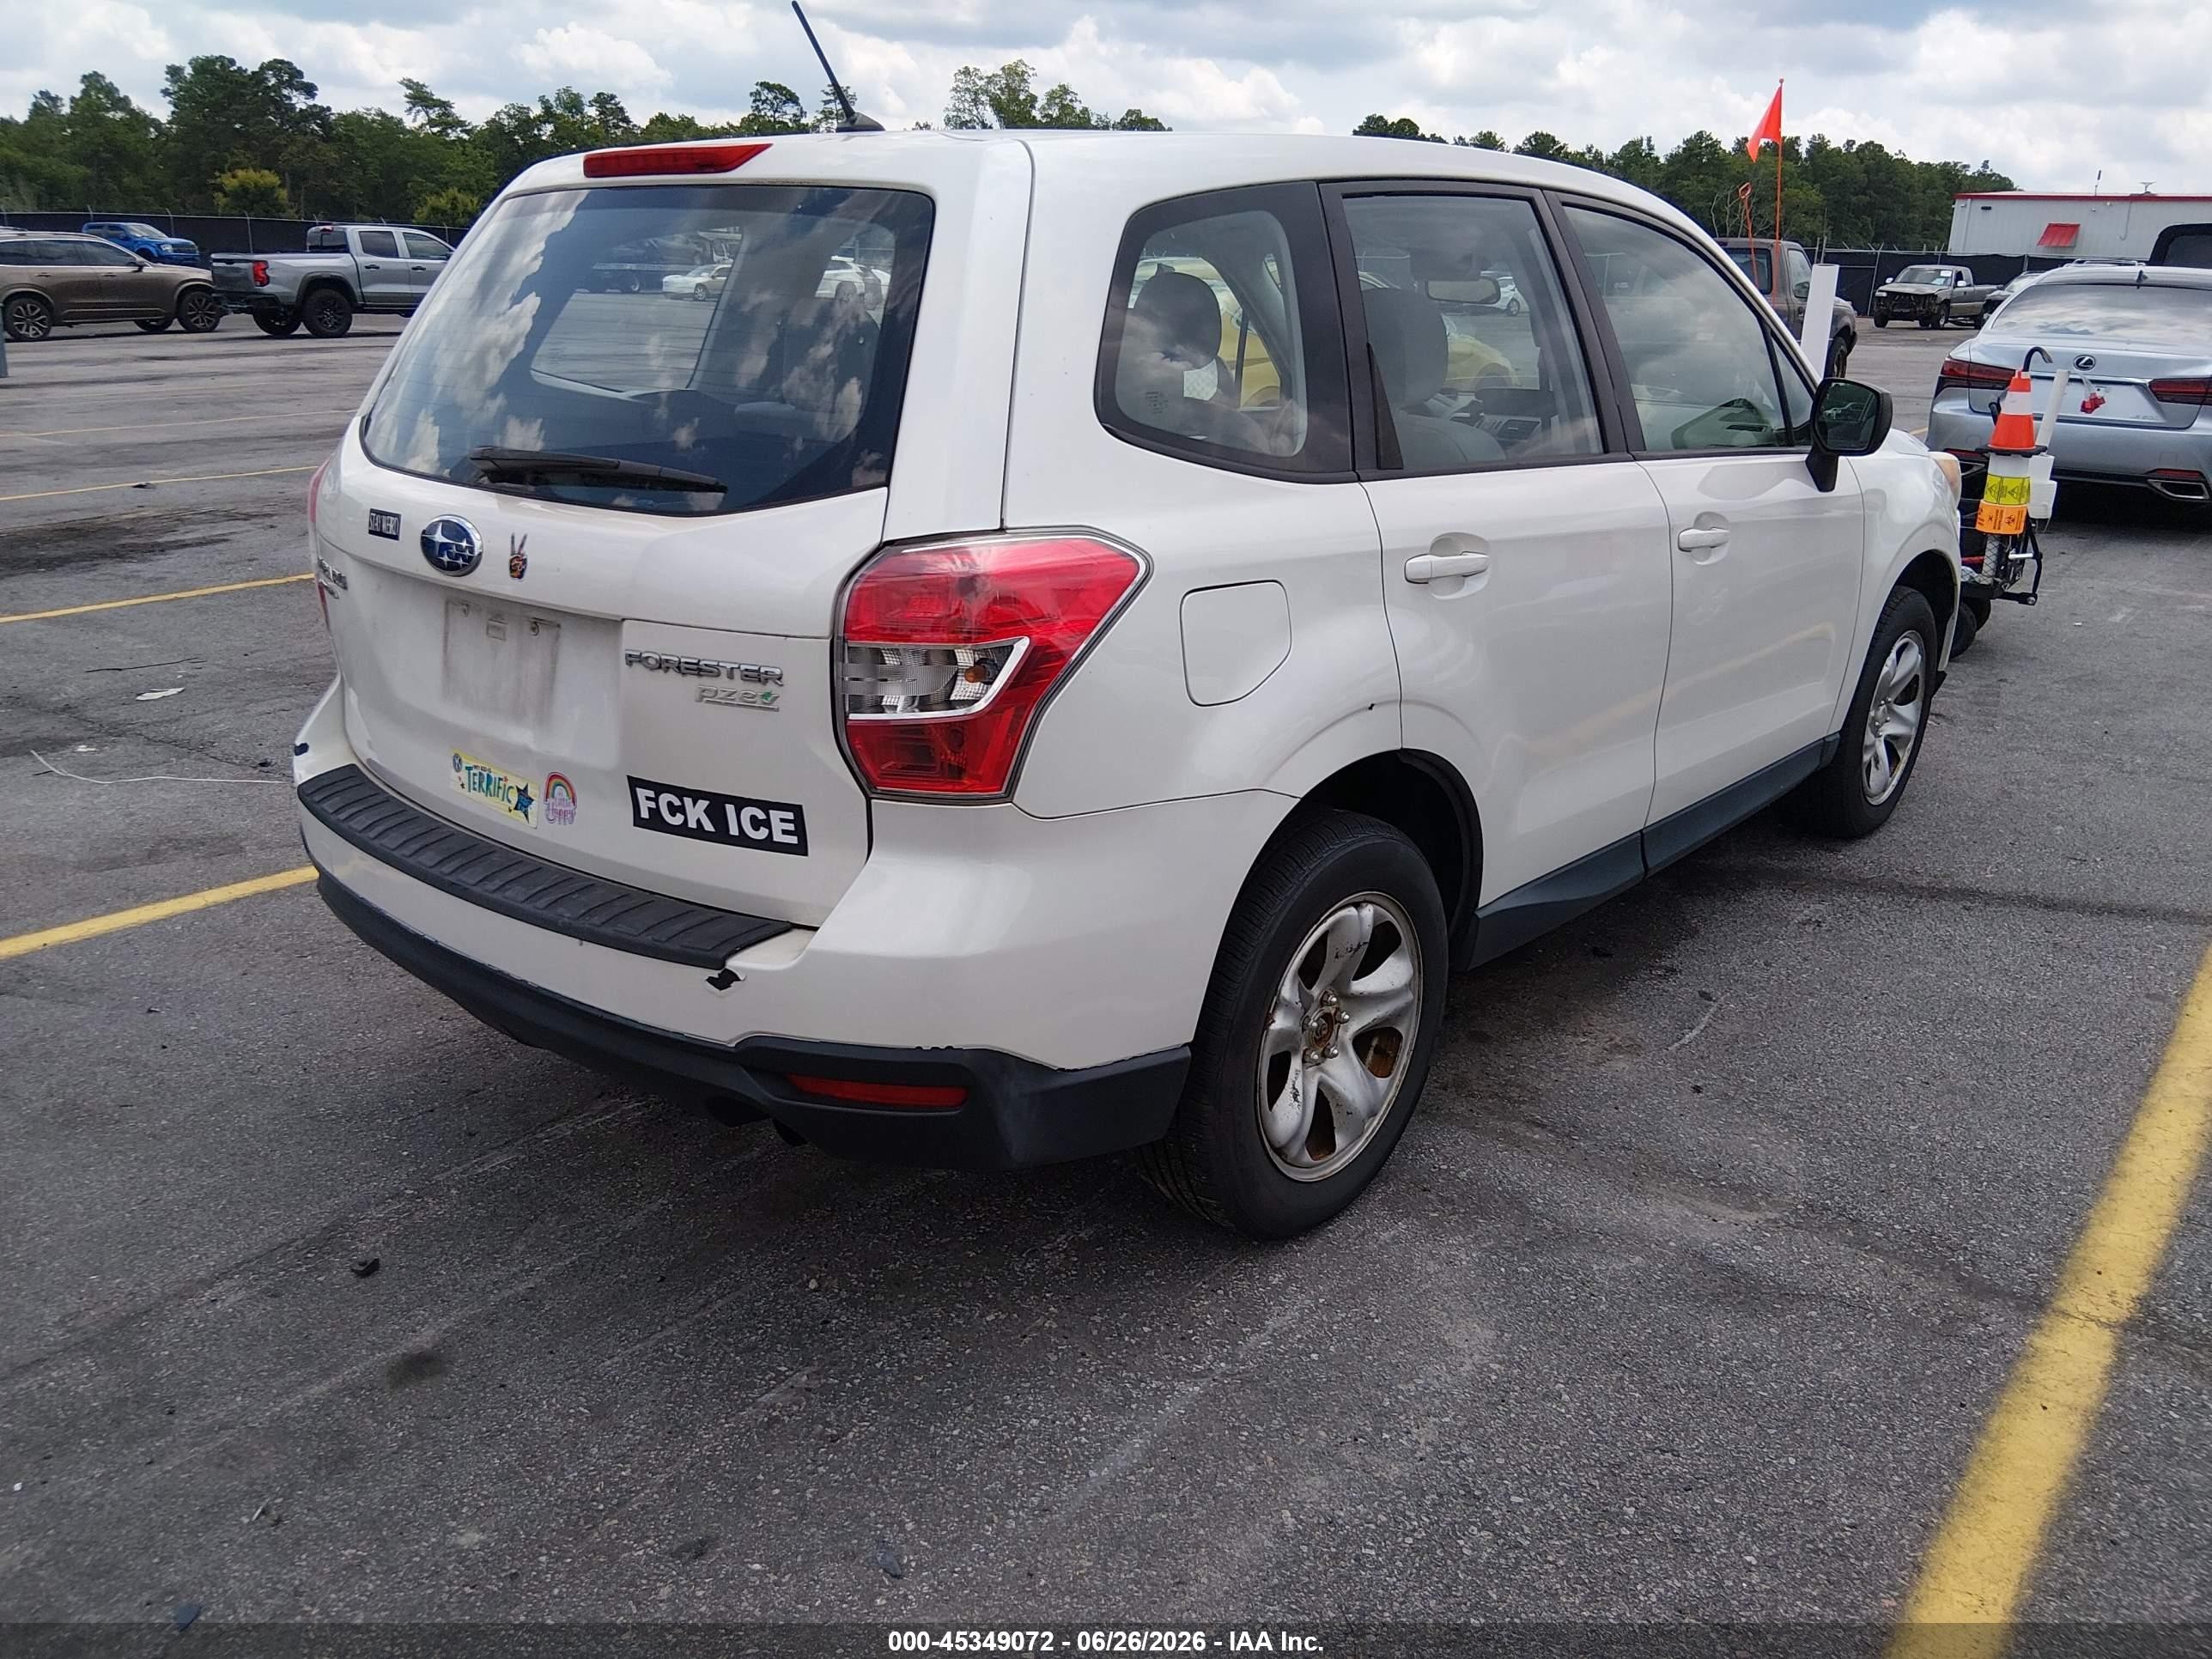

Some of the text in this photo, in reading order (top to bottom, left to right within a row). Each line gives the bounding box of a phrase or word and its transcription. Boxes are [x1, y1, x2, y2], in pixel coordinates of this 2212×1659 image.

[624, 648, 784, 687] FORESTER
[635, 787, 799, 845] FCK ICE
